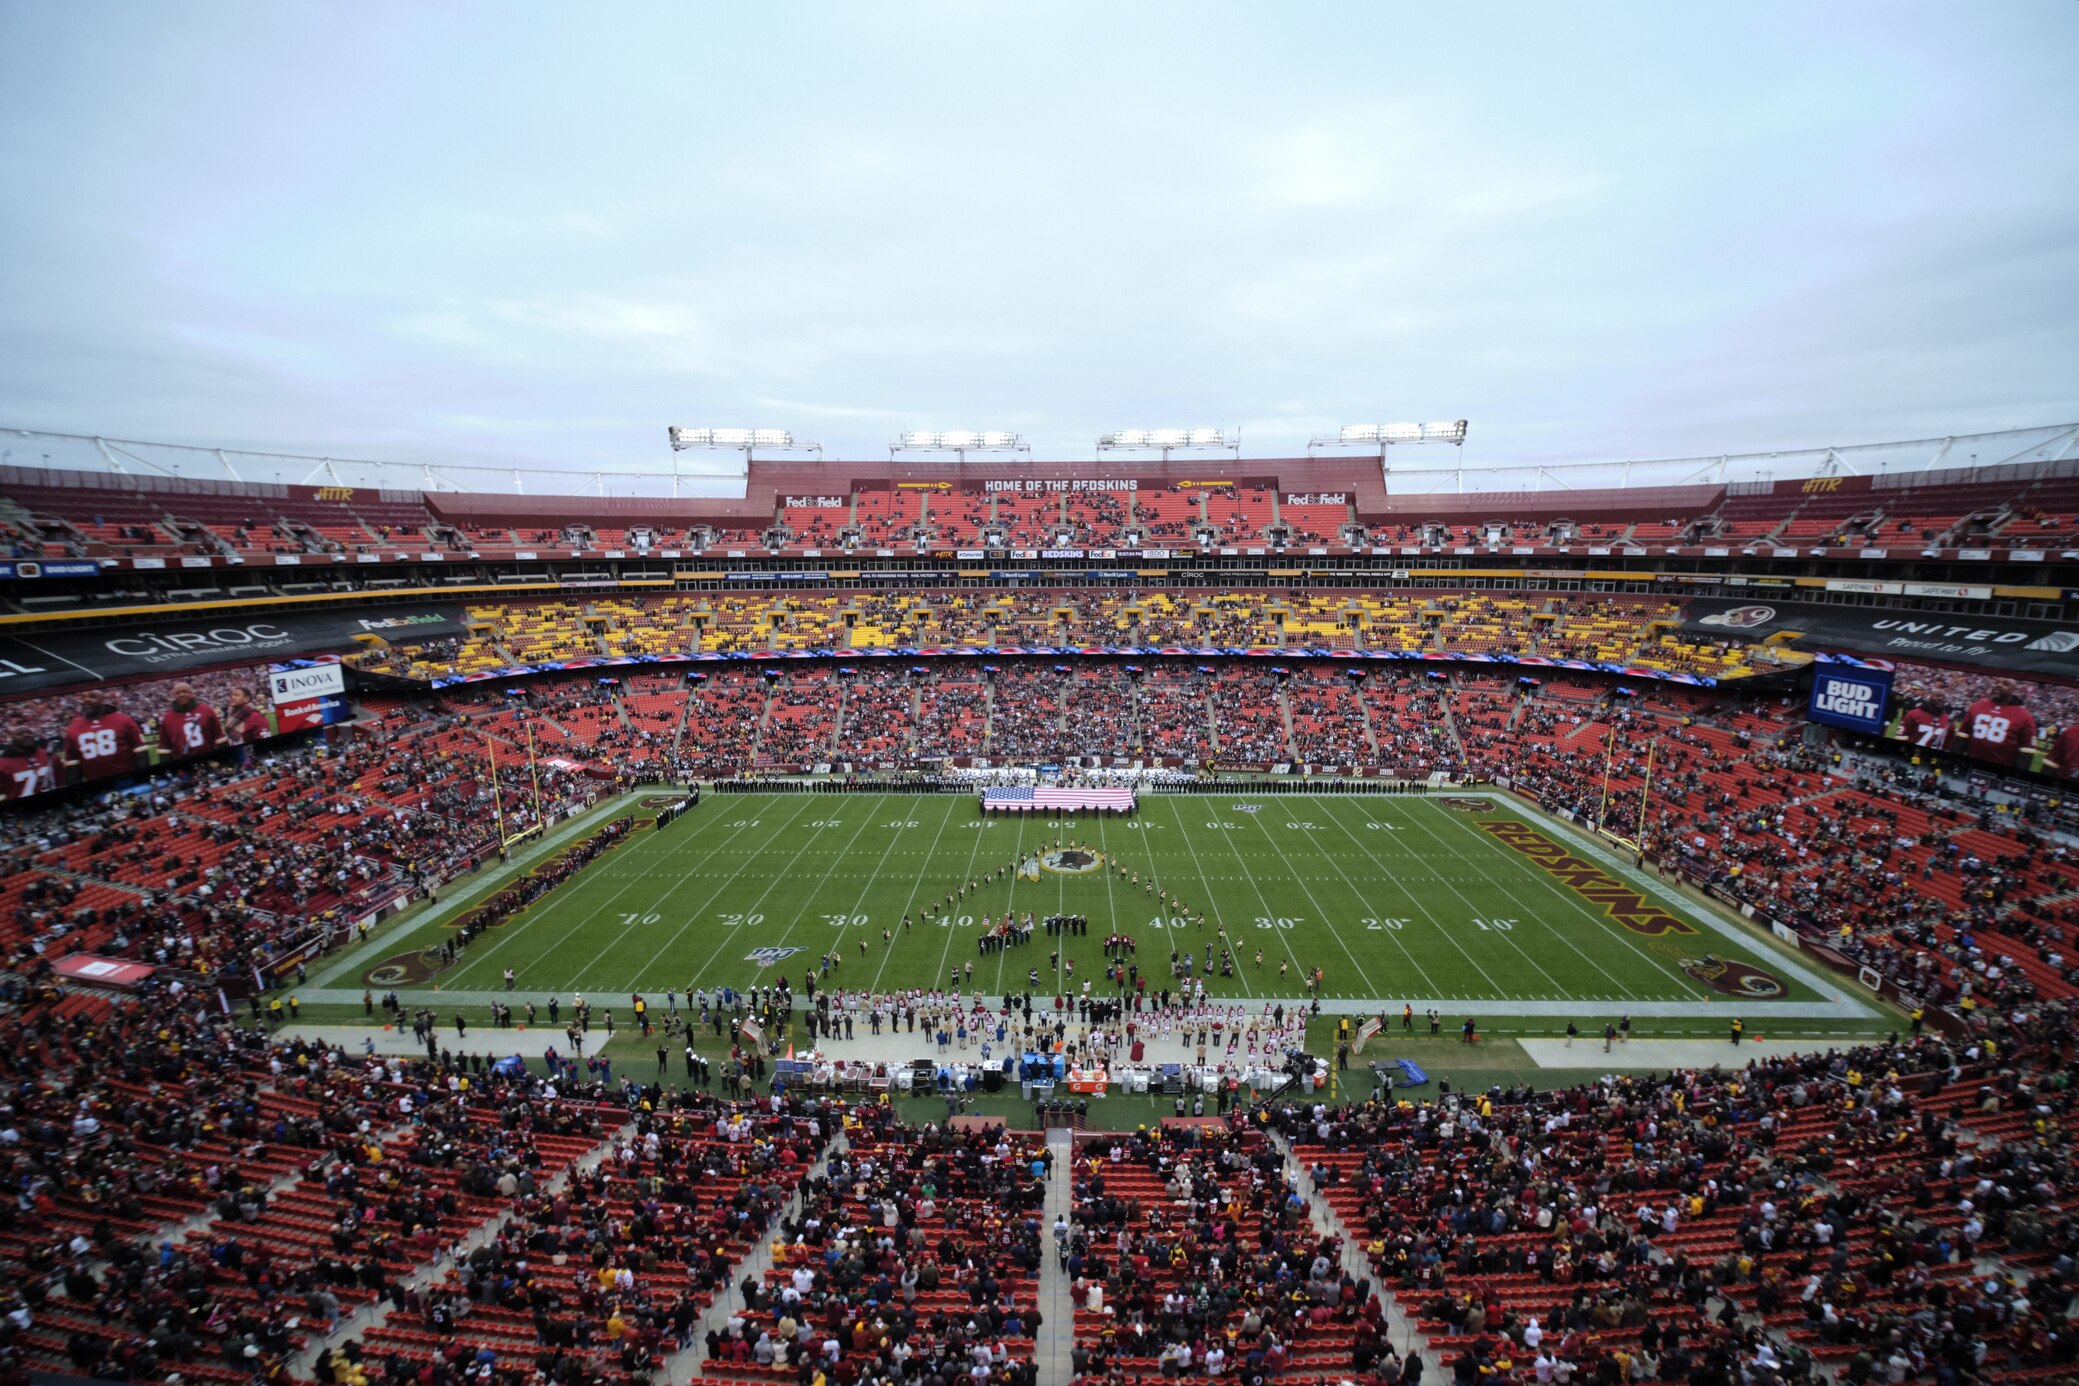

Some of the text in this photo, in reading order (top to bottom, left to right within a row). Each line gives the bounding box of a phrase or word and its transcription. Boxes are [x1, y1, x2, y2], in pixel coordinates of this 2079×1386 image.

[985, 480, 1138, 491] HOME OF THE REDSKINS
[786, 496, 842, 508] FedExField
[1287, 494, 1345, 504] FedExField
[1842, 582, 1874, 591] SAFEWAY
[1921, 586, 1957, 595] SAFEWAY
[358, 614, 446, 630] FedExField
[1872, 620, 2028, 643] UNITED
[144, 638, 296, 664] ULTRA PREMIUM VODKA
[1887, 637, 1994, 656] Proud to fly
[290, 673, 333, 689] INOVA
[1826, 680, 1872, 700] BUD
[284, 706, 301, 717] Bank
[312, 700, 340, 711] America
[1816, 694, 1879, 719] LIGHT
[1973, 713, 2010, 743] 68
[77, 728, 117, 760] 68
[1474, 820, 1701, 936] REDSKINS
[722, 914, 764, 926] 20
[828, 914, 869, 926] 30
[935, 915, 974, 927] 40
[1254, 917, 1295, 929] 30
[1361, 918, 1403, 930] 20
